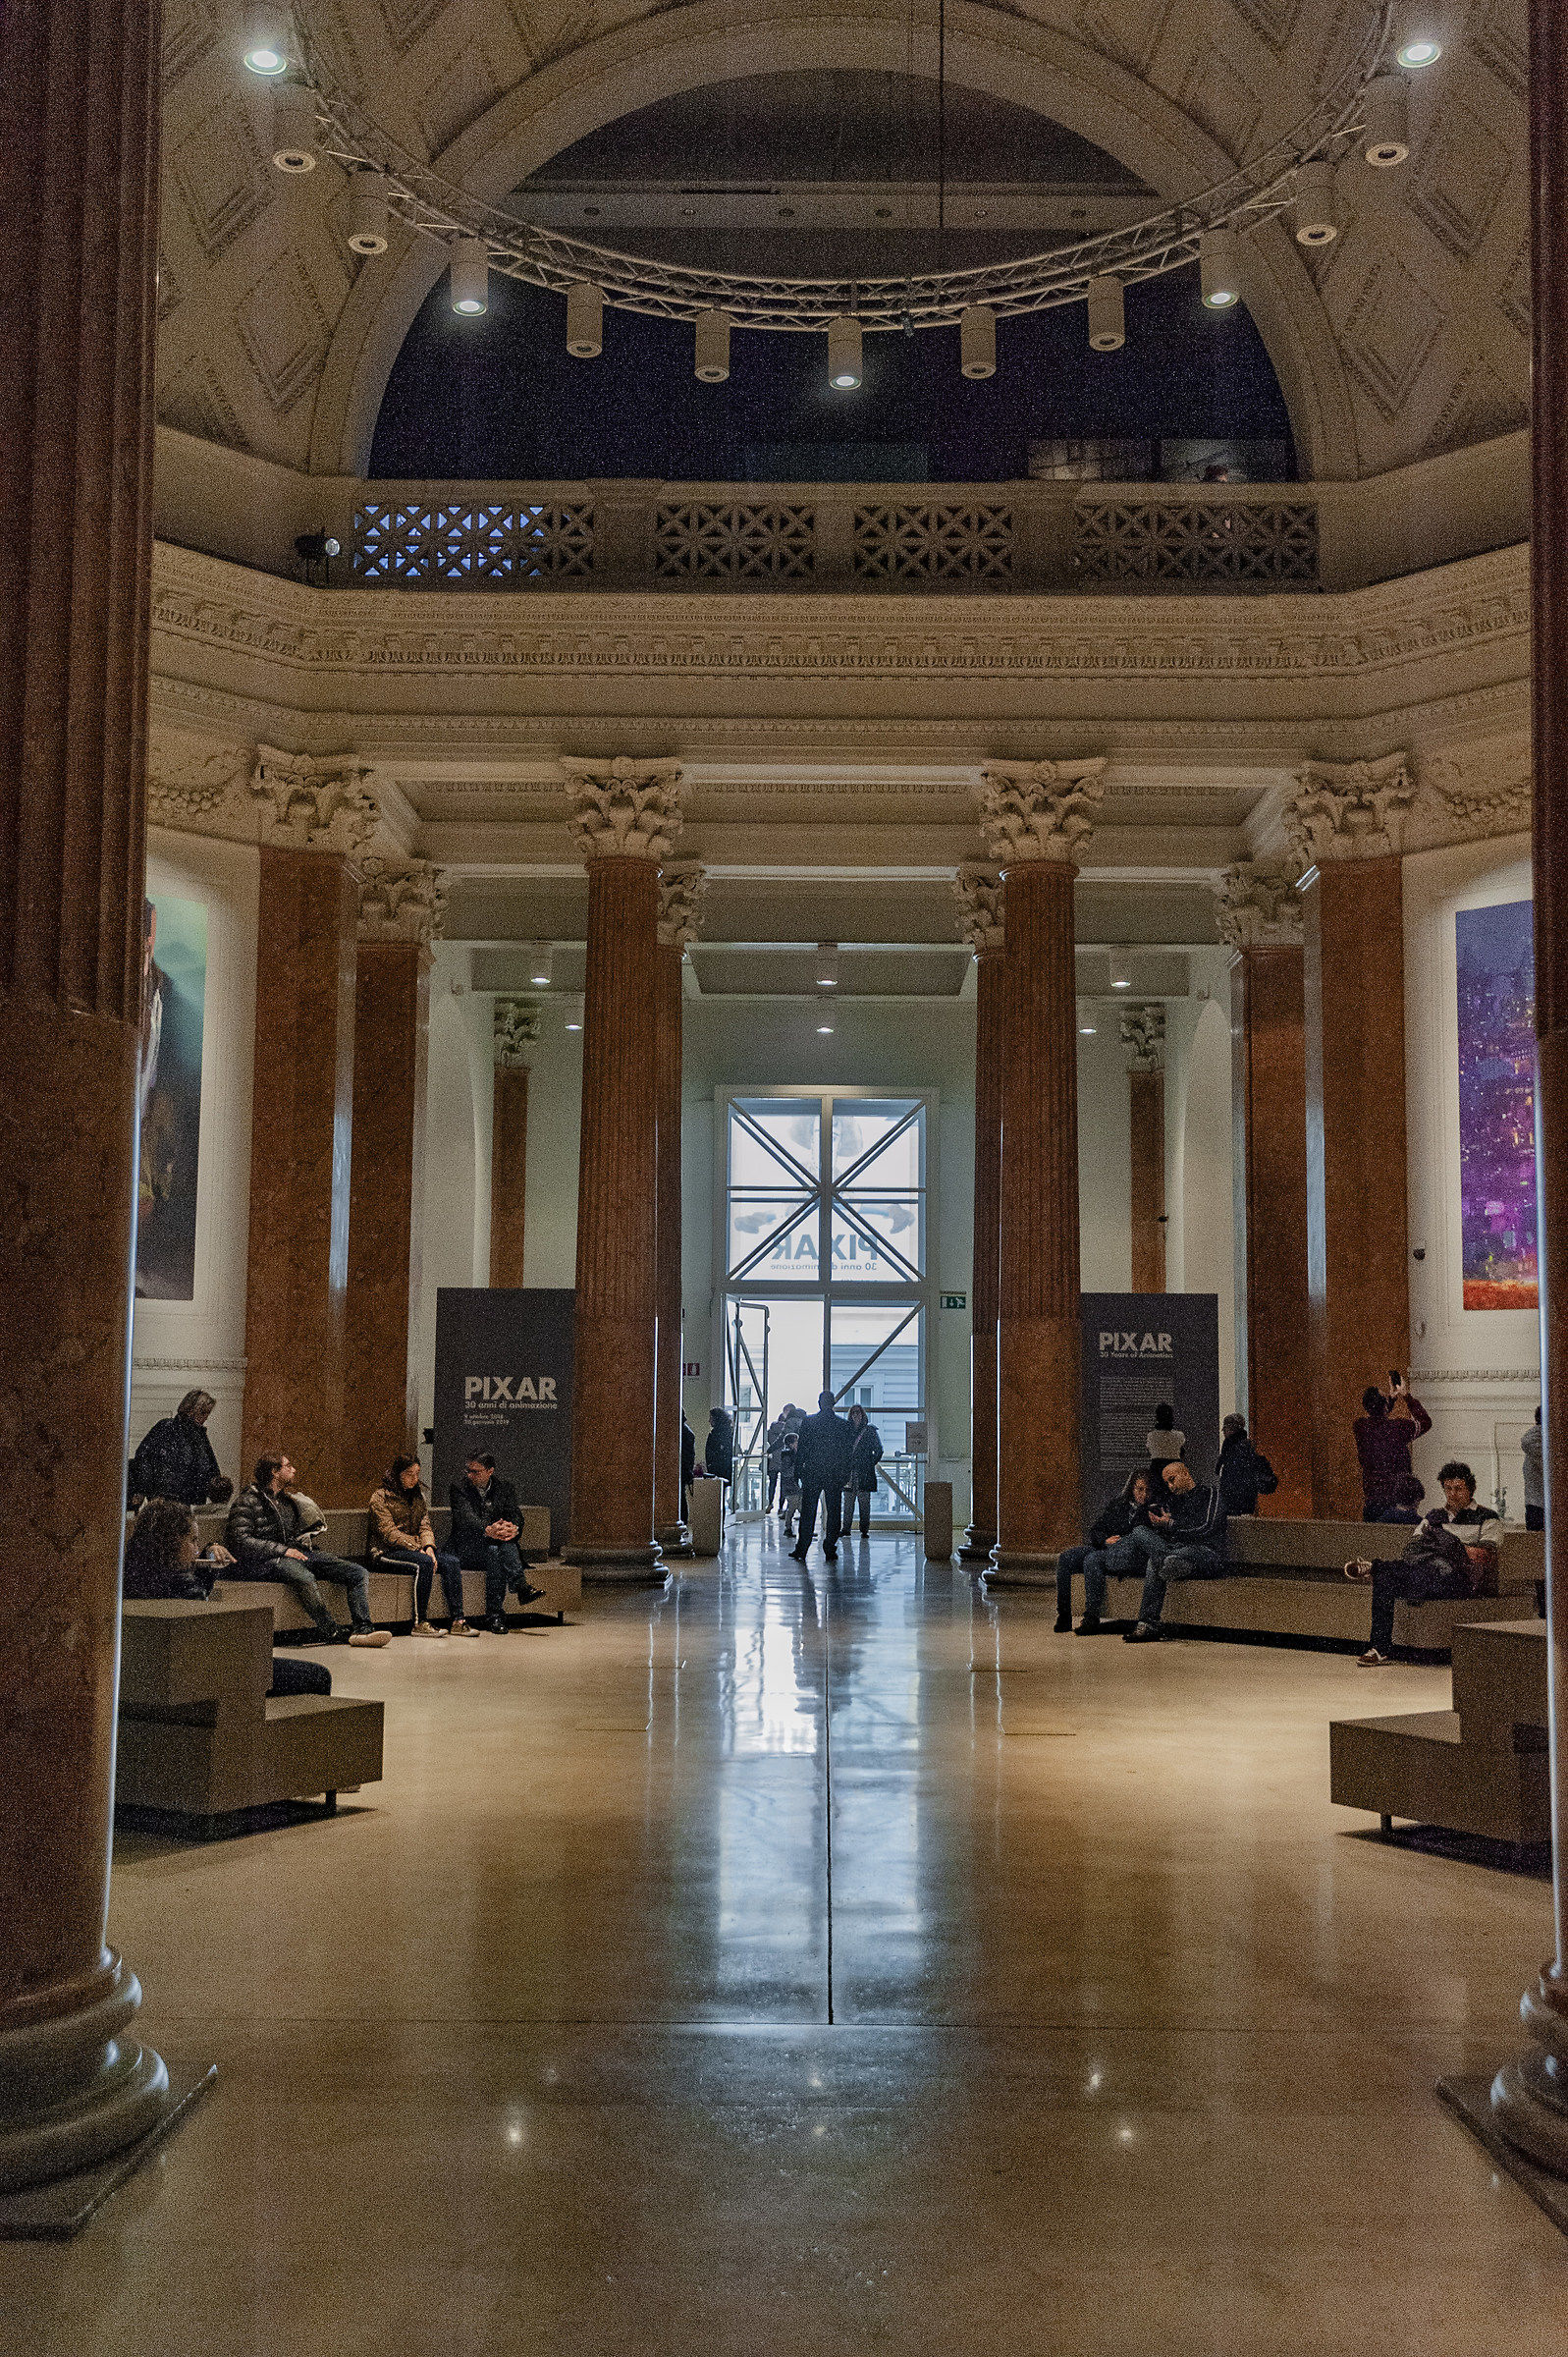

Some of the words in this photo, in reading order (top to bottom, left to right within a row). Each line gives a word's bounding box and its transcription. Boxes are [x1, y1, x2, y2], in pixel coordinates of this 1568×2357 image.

[1099, 1332, 1173, 1351] PIXAR
[464, 1376, 558, 1400] PIXAR
[464, 1400, 477, 1409] 30
[478, 1400, 498, 1409] anni
[499, 1400, 508, 1409] di
[509, 1401, 558, 1410] animazione
